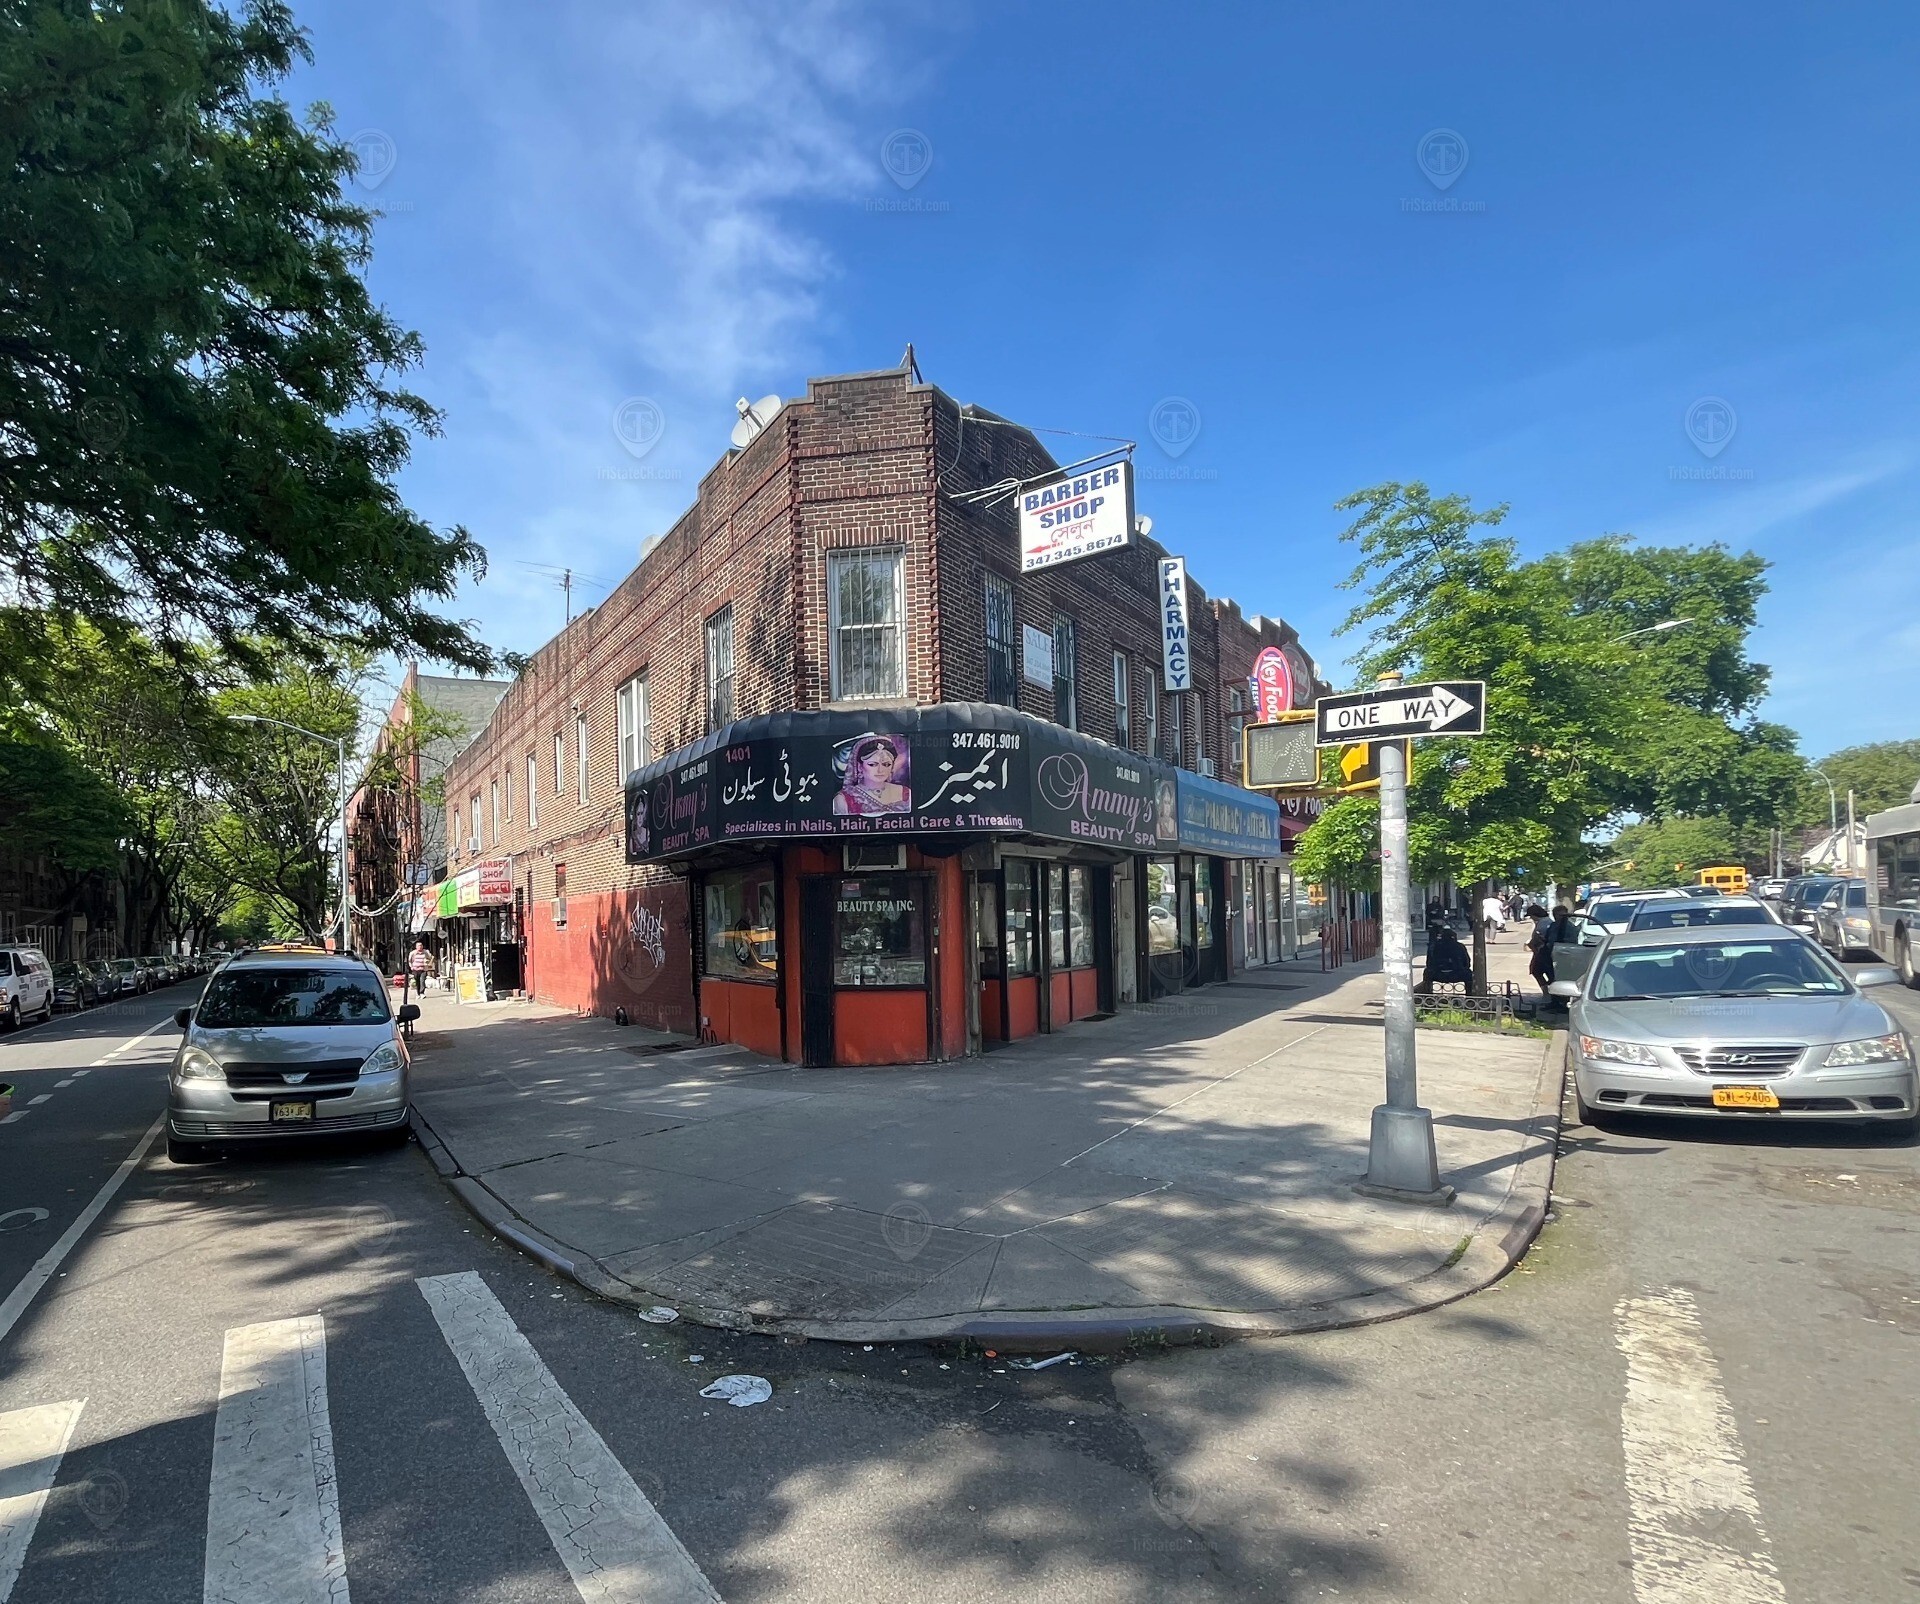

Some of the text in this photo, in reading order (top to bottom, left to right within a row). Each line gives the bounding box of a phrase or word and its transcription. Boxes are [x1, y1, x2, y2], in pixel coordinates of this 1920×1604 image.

[1025, 468, 1119, 511] BARBER
[1040, 496, 1104, 529] SHOP
[1051, 518, 1095, 543] সেলুন
[1026, 534, 1122, 568] 347.345.8674
[1165, 563, 1186, 688] PHARMACY
[1261, 656, 1282, 686] Key
[1251, 681, 1259, 707] FRESH
[1338, 698, 1456, 728] ONE WAY
[952, 732, 1020, 750] 347.461.9018
[725, 746, 750, 763] 1401
[1038, 752, 1153, 834] Ammy's
[1304, 796, 1321, 816] Foo
[725, 814, 1024, 835] Specializes in Nails, Hair, Facial Care & Threading
[1071, 820, 1156, 846] BEAUTY SPA
[662, 826, 710, 851] BEAUTY SPA
[483, 871, 503, 879] SHOP
[837, 900, 916, 912] BEAUTY SPA INC.
